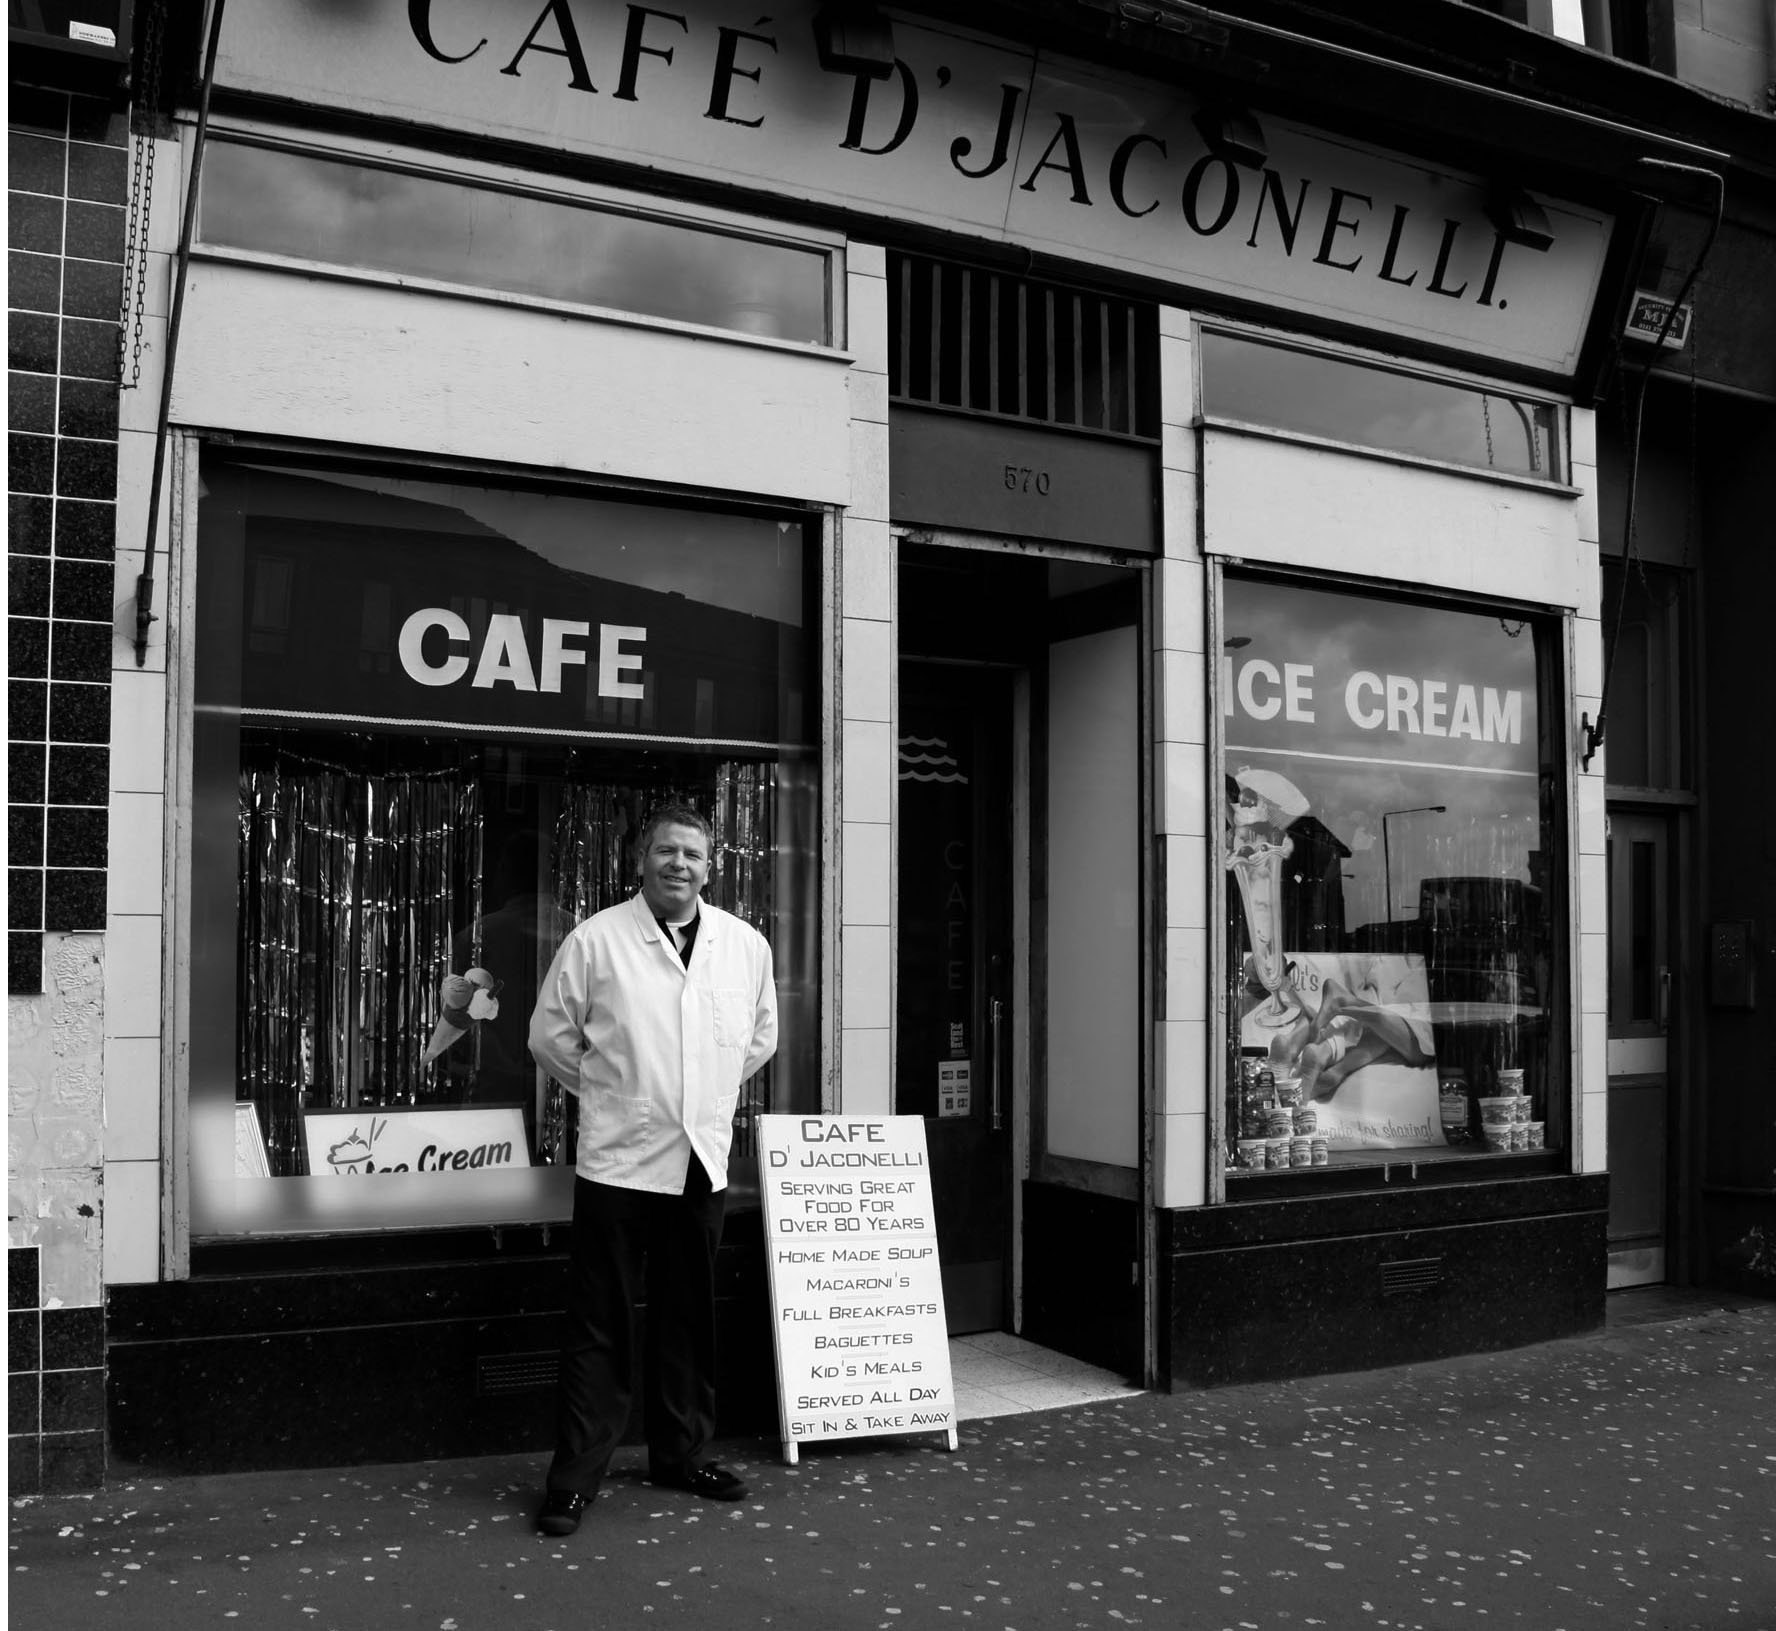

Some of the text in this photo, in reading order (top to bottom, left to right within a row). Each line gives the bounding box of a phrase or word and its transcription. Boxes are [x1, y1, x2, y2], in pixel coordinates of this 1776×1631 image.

[407, 0, 779, 129] CAFÉ
[1003, 465, 1051, 497] 570
[398, 608, 647, 700] CAFE
[1224, 656, 1522, 745] ICE CREAM
[943, 840, 967, 990] CAFE
[801, 1119, 885, 1143] CAFE
[1383, 1115, 1434, 1143] sharing!
[418, 1141, 512, 1172] Cream
[769, 1144, 923, 1168] D' JACONELLI
[780, 1180, 916, 1196] SERVING GREAT
[805, 1199, 895, 1214] FOOD FOR
[780, 1216, 925, 1233] OVER 80 YEARS
[778, 1247, 933, 1264] HOME MADE SOUP
[806, 1271, 910, 1292] MACARONI'S
[782, 1303, 937, 1321] FULL BREAKFASTS
[815, 1333, 913, 1349] BAGUETTES
[811, 1359, 922, 1379] KID'S MEALS
[797, 1387, 941, 1410] SERVED ALL DAY
[791, 1412, 951, 1435] SIT IN & TAKE AWAY
